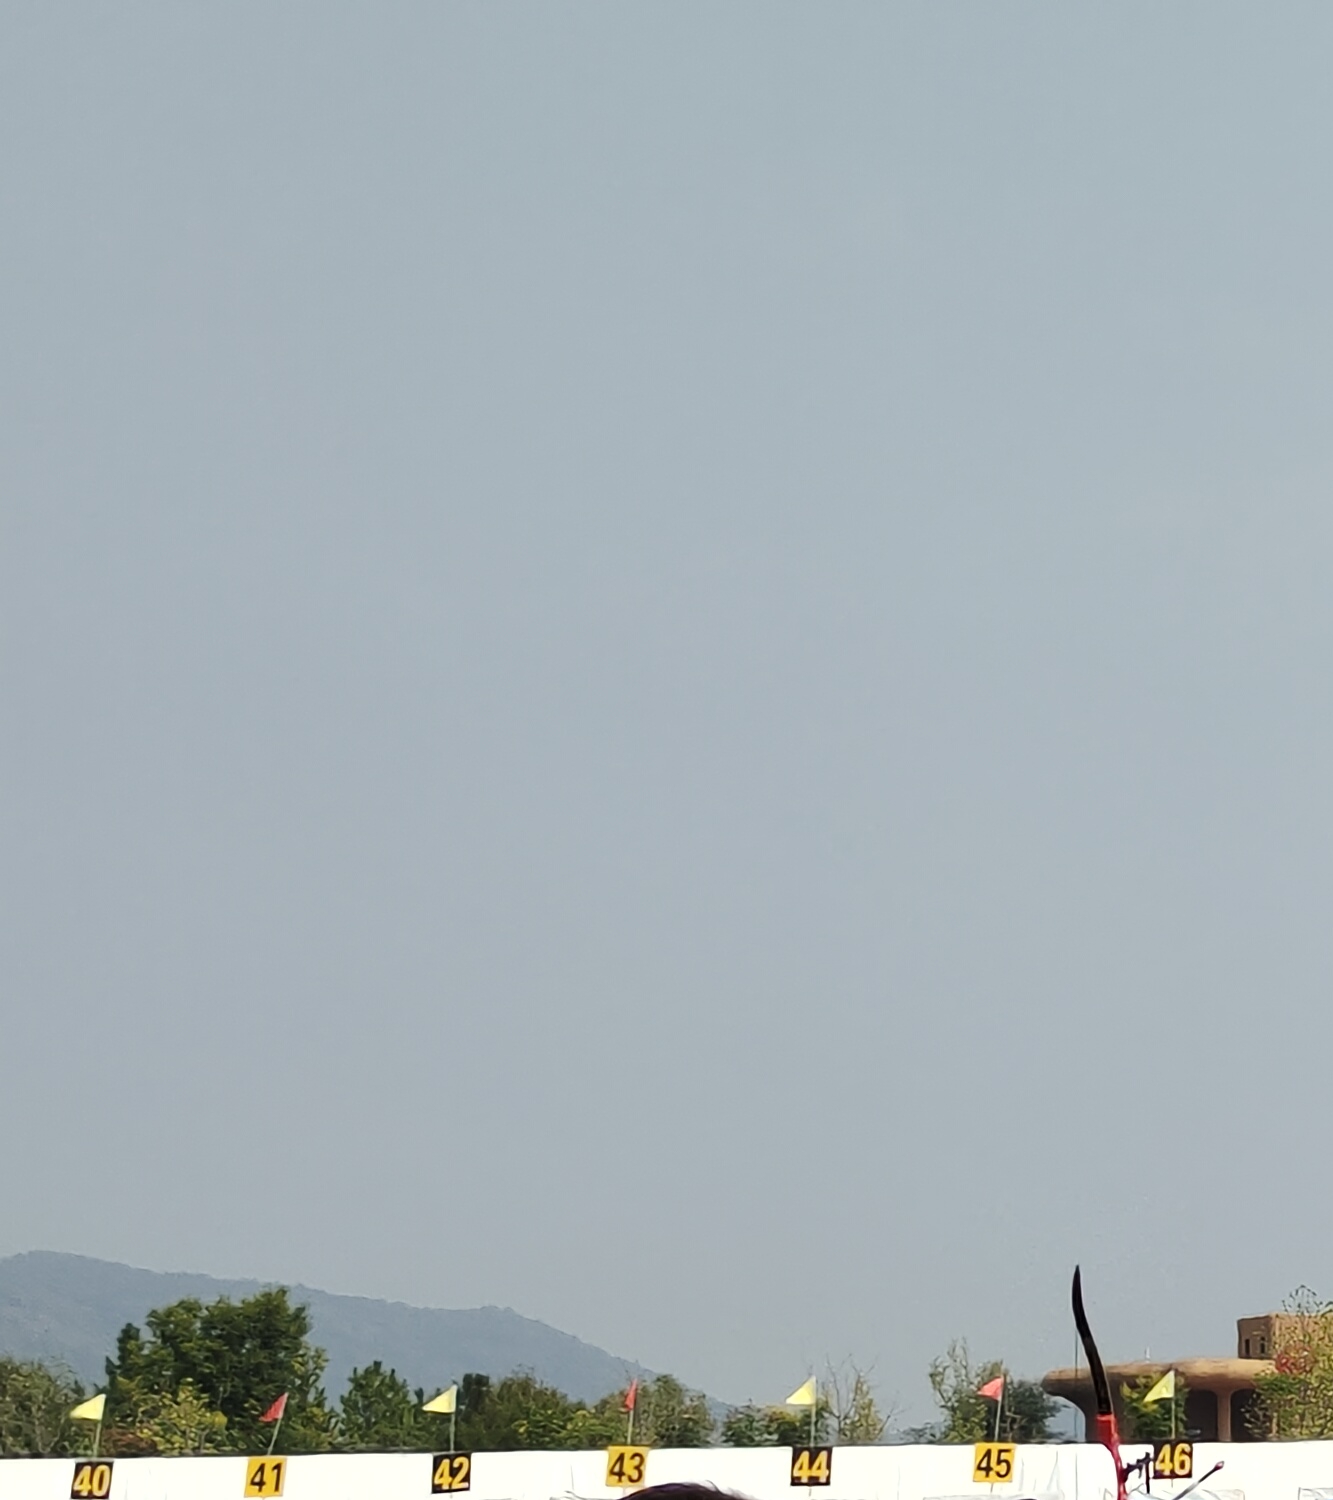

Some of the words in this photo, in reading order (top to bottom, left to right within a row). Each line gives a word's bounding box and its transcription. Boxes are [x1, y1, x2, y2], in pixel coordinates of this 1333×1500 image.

[435, 1456, 468, 1489] 42
[609, 1452, 645, 1483] 43
[794, 1450, 829, 1482] 44
[977, 1448, 1011, 1479] 45
[1157, 1443, 1190, 1475] 46
[74, 1464, 111, 1496] 40
[250, 1462, 282, 1492] 41
